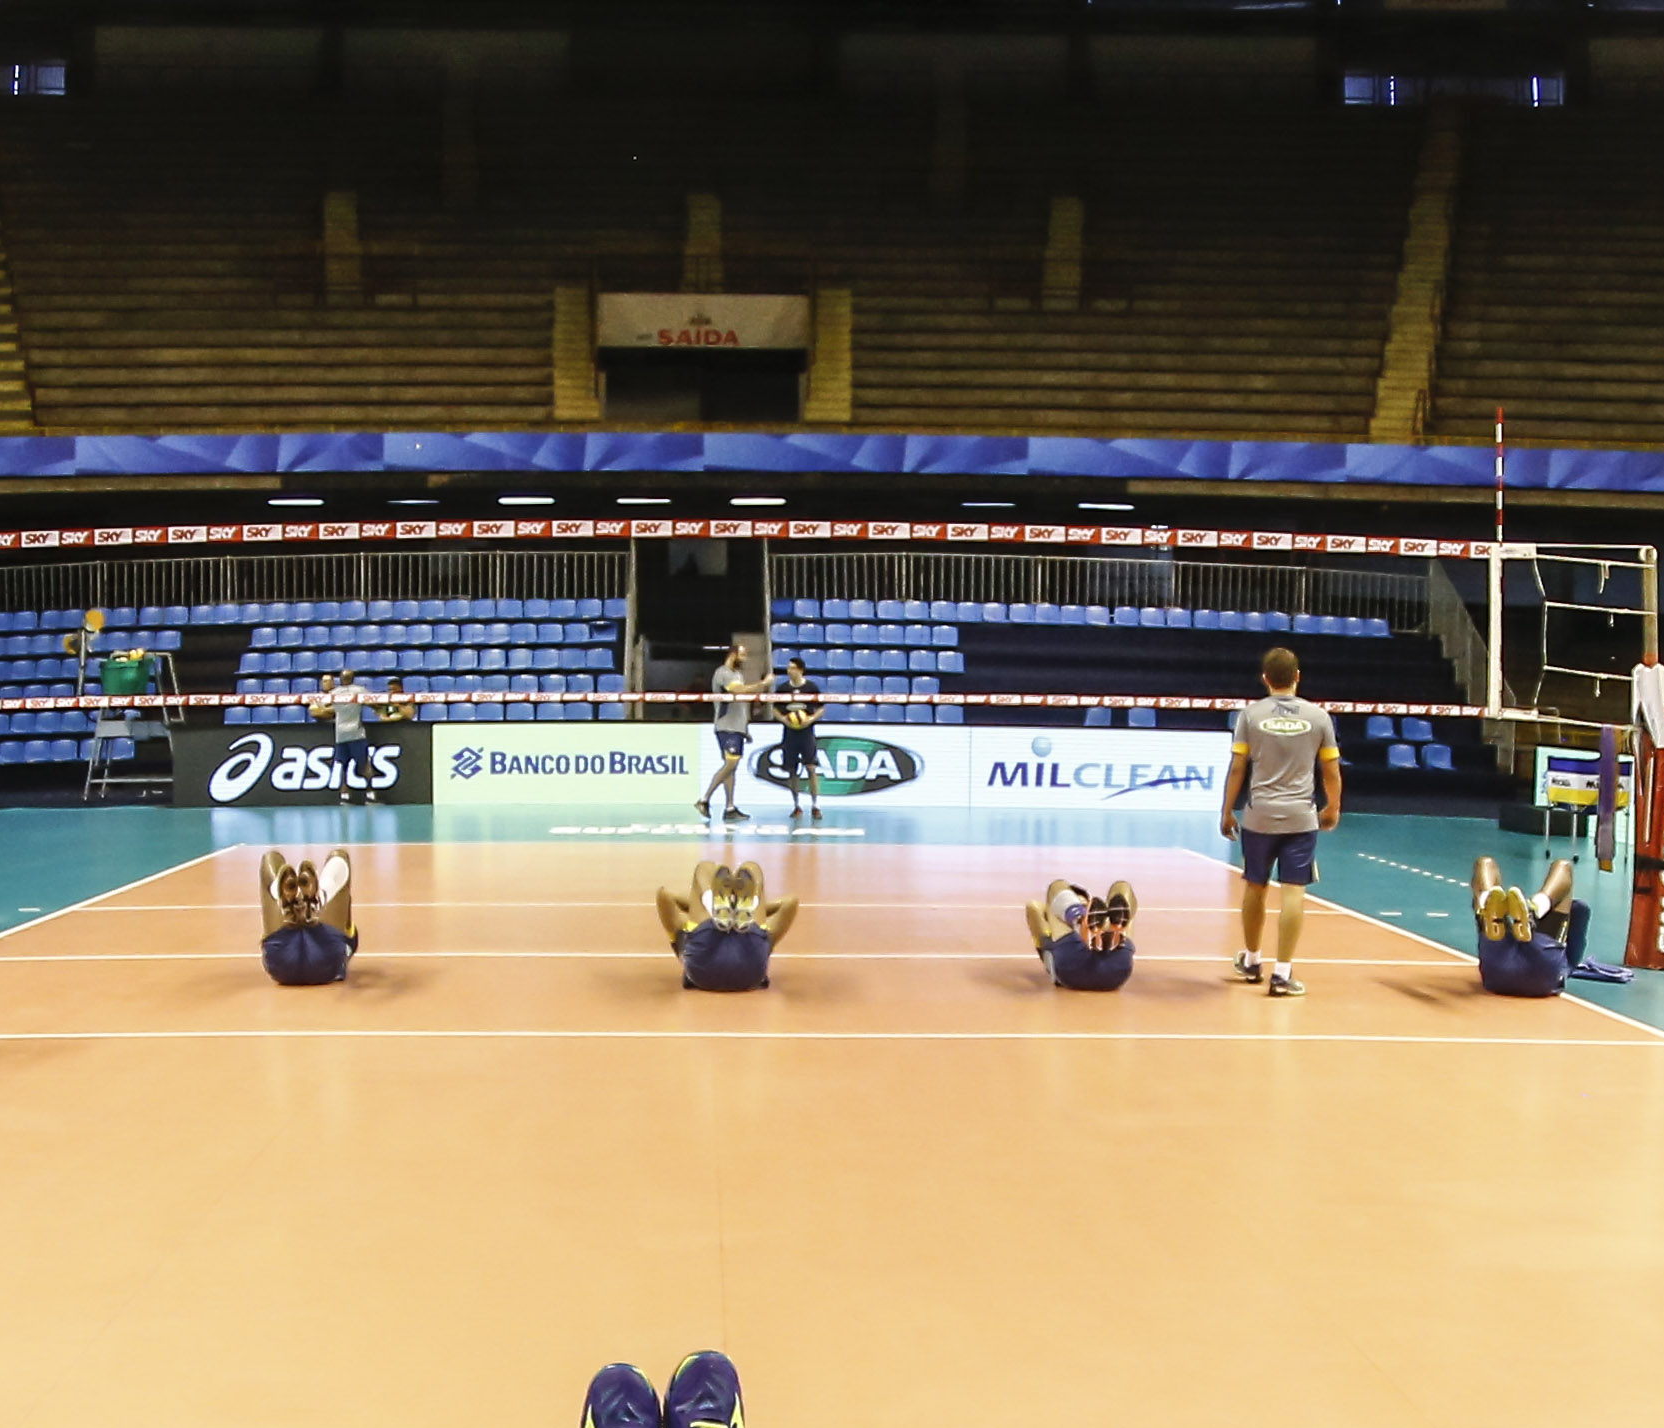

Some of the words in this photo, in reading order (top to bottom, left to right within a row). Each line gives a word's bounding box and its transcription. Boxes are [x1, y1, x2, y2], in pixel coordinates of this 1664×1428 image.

[657, 326, 739, 346] SAÍDA
[25, 533, 51, 545] SKY
[62, 532, 89, 544] SKY
[98, 531, 123, 542] SKY
[135, 530, 162, 542] SKY
[172, 529, 197, 540] SKY
[208, 527, 237, 540] SKY
[246, 527, 272, 537] SKY
[284, 525, 313, 537] SKY
[322, 526, 348, 536] SKY
[361, 524, 390, 537] SKY
[400, 524, 426, 535] SKY
[438, 522, 468, 535] SKY
[477, 523, 503, 534] SKY
[516, 522, 546, 535] SKY
[556, 522, 582, 533] SKY
[595, 521, 625, 534] SKY
[636, 522, 662, 533] SKY
[674, 521, 704, 534] SKY
[715, 523, 741, 534] SKY
[754, 522, 784, 535] SKY
[793, 524, 820, 534] SKY
[833, 523, 863, 536] SKY
[873, 524, 900, 535] SKY
[912, 524, 942, 536] SKY
[951, 526, 977, 537] SKY
[990, 525, 1019, 538] SKY
[1029, 528, 1055, 539] SKY
[1066, 527, 1096, 541] SKY
[1105, 530, 1131, 540] SKY
[1144, 530, 1172, 543] SKY
[1182, 532, 1207, 542] SKY
[1219, 532, 1248, 546] SKY
[1257, 535, 1283, 545] SKY
[1294, 535, 1322, 549] SKY
[1331, 538, 1356, 549] SKY
[1367, 539, 1395, 552] SKY
[1404, 542, 1428, 552] SKY
[1438, 541, 1466, 555] SKY
[1475, 544, 1490, 555] SK
[490, 751, 571, 776] BANCO
[575, 756, 605, 775] DO
[609, 750, 689, 776] BRASIL
[987, 760, 1215, 790] MILCLEAN
